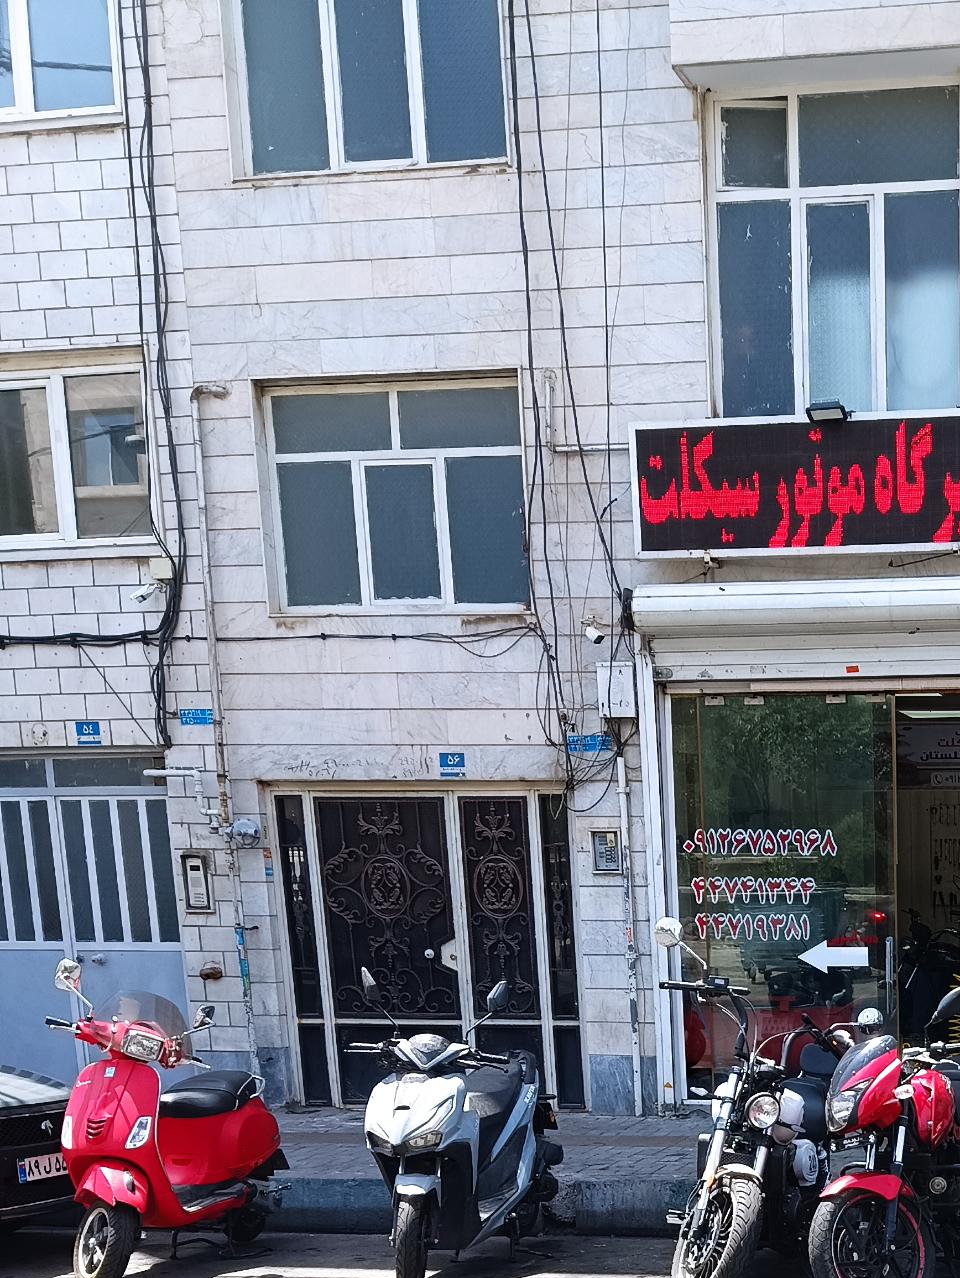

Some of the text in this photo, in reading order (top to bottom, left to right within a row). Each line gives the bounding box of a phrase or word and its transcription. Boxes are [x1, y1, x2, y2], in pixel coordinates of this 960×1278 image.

[639, 431, 761, 544] سیکلت
[767, 429, 866, 548] موتور
[683, 827, 838, 856] ۰۹۱۲۶۷۵۲۹۶۸
[690, 876, 816, 905] ۴۴۷۴۱۳۴۴
[695, 912, 811, 941] ۴۴۷۱۹۳۸۱
[28, 1159, 42, 1177] ۸۹
[44, 1157, 52, 1174] ل
